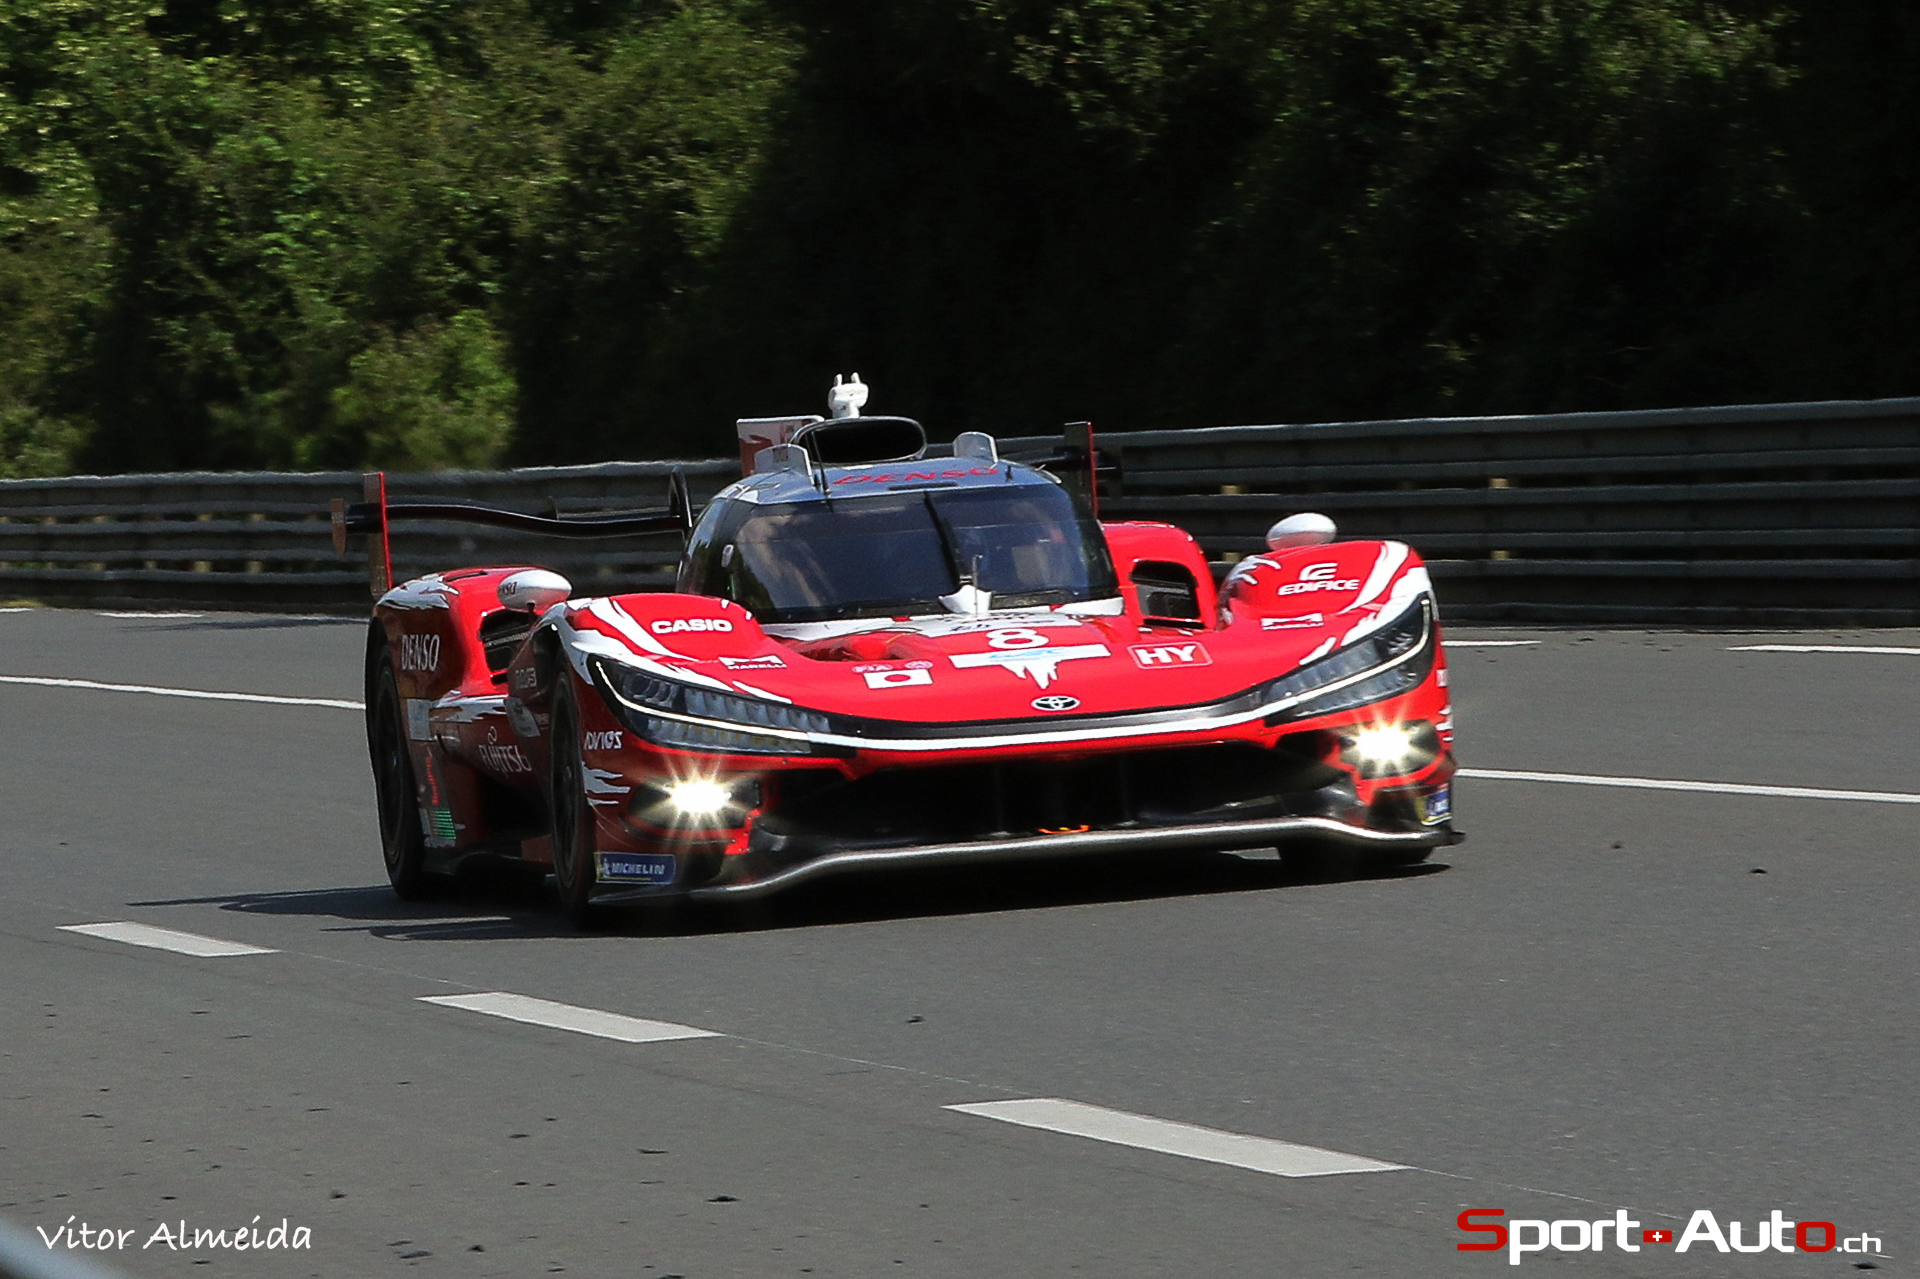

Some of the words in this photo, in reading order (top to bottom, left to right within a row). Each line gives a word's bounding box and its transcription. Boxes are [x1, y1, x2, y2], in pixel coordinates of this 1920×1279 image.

[832, 467, 999, 486] DENSO
[1277, 579, 1360, 596] EDIFICE
[651, 618, 734, 634] CASIO
[985, 628, 1050, 650] 8
[401, 634, 440, 671] DENSO
[1135, 645, 1197, 665] HY
[611, 860, 666, 876] MICHELIN
